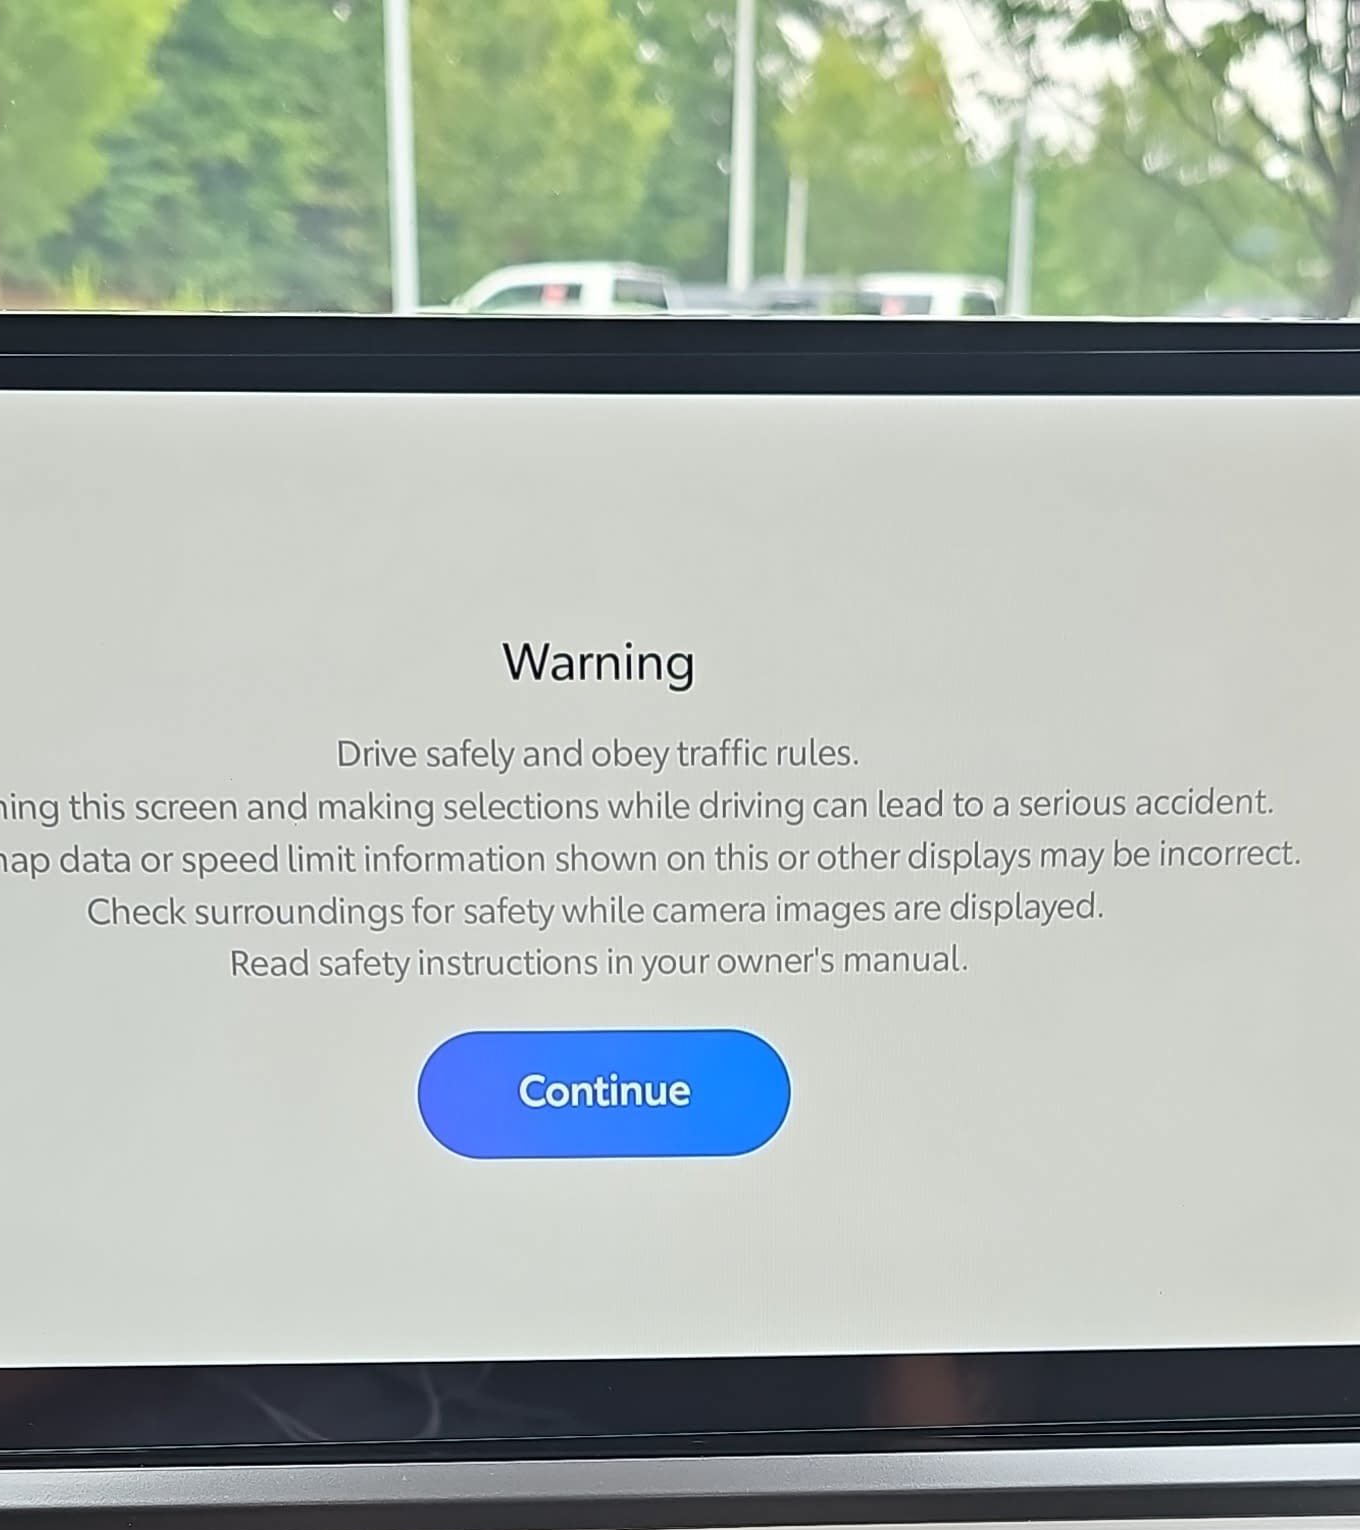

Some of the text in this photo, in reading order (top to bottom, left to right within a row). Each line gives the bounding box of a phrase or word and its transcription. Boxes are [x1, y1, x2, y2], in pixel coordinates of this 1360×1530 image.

[502, 641, 694, 692] Warning
[338, 737, 859, 775] Drive safely and obey traffic rules.
[68, 791, 126, 821] this
[135, 799, 238, 821] screen
[247, 791, 307, 821] and
[318, 791, 434, 828] making
[444, 791, 599, 820] selections
[607, 790, 691, 820] while
[699, 790, 804, 826] driving
[813, 797, 867, 819] can
[878, 788, 943, 818] lead
[952, 792, 984, 818] to
[993, 796, 1009, 817] a
[1019, 788, 1126, 817] serious
[1135, 786, 1273, 816] accident.
[59, 844, 131, 873] data
[140, 852, 174, 873] or
[182, 844, 279, 880] speed
[288, 843, 357, 873] limit
[364, 843, 545, 873] information
[556, 843, 657, 872] shown
[667, 851, 705, 872] on
[714, 842, 769, 871] this
[778, 850, 810, 871] or
[817, 841, 901, 871] other
[908, 840, 1031, 876] displays
[1040, 847, 1105, 875] may
[1113, 839, 1151, 868] be
[1160, 839, 1300, 867] incorrect.
[87, 890, 1103, 932] Check surroundings for safety while camera images are displayed.
[231, 943, 968, 984] Read safety instructions in your owner's manual.
[518, 1074, 691, 1108] Continue
